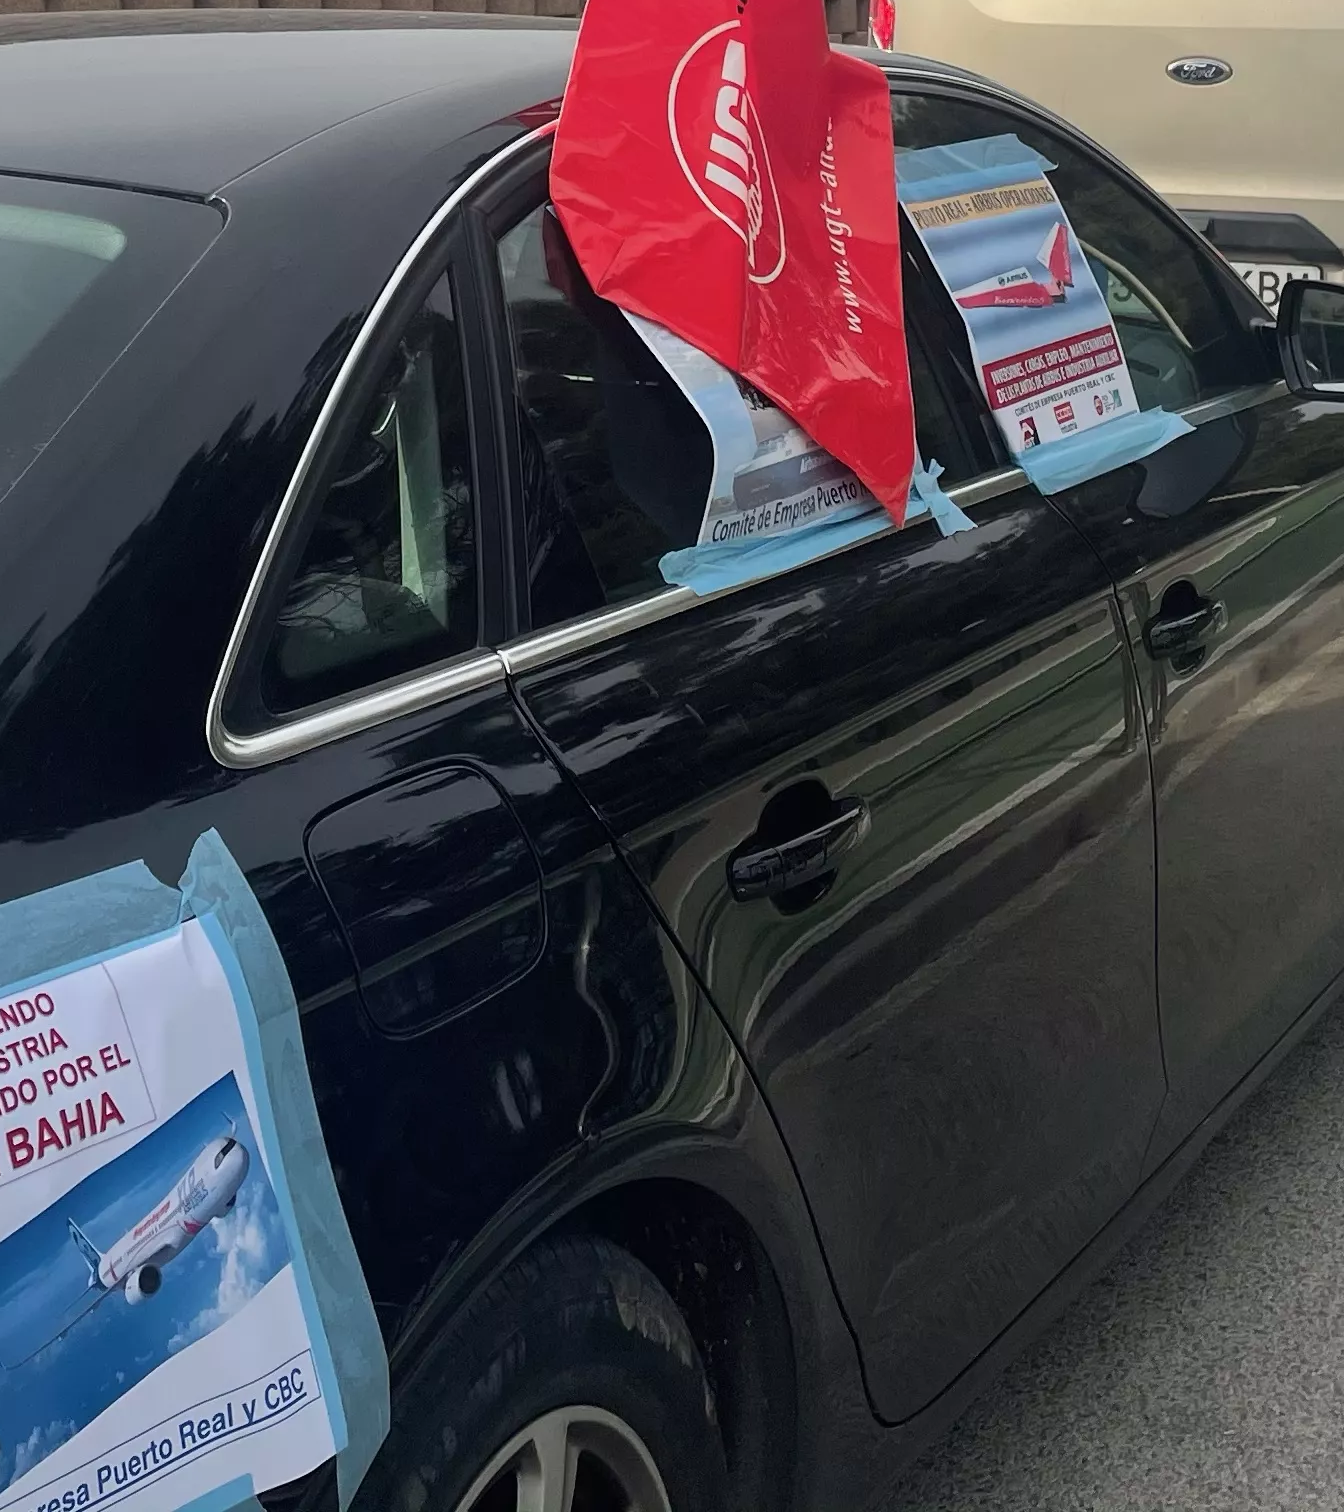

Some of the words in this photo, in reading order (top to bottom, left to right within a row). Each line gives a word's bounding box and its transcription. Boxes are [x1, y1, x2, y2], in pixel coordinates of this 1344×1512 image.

[941, 199, 969, 222] REAL
[970, 191, 1003, 214] AIRBUS
[1064, 384, 1087, 397] PUERTO
[712, 509, 757, 543] Comité
[757, 505, 773, 532] de
[773, 494, 817, 529] Empresa
[816, 480, 857, 511] Puerto
[43, 1055, 96, 1097] POR
[99, 1042, 132, 1073] EL
[4, 1091, 127, 1170] BAHIA
[96, 1437, 174, 1495] Puerto
[177, 1403, 234, 1450] Real
[236, 1398, 257, 1425] y
[263, 1366, 306, 1410] CBC
